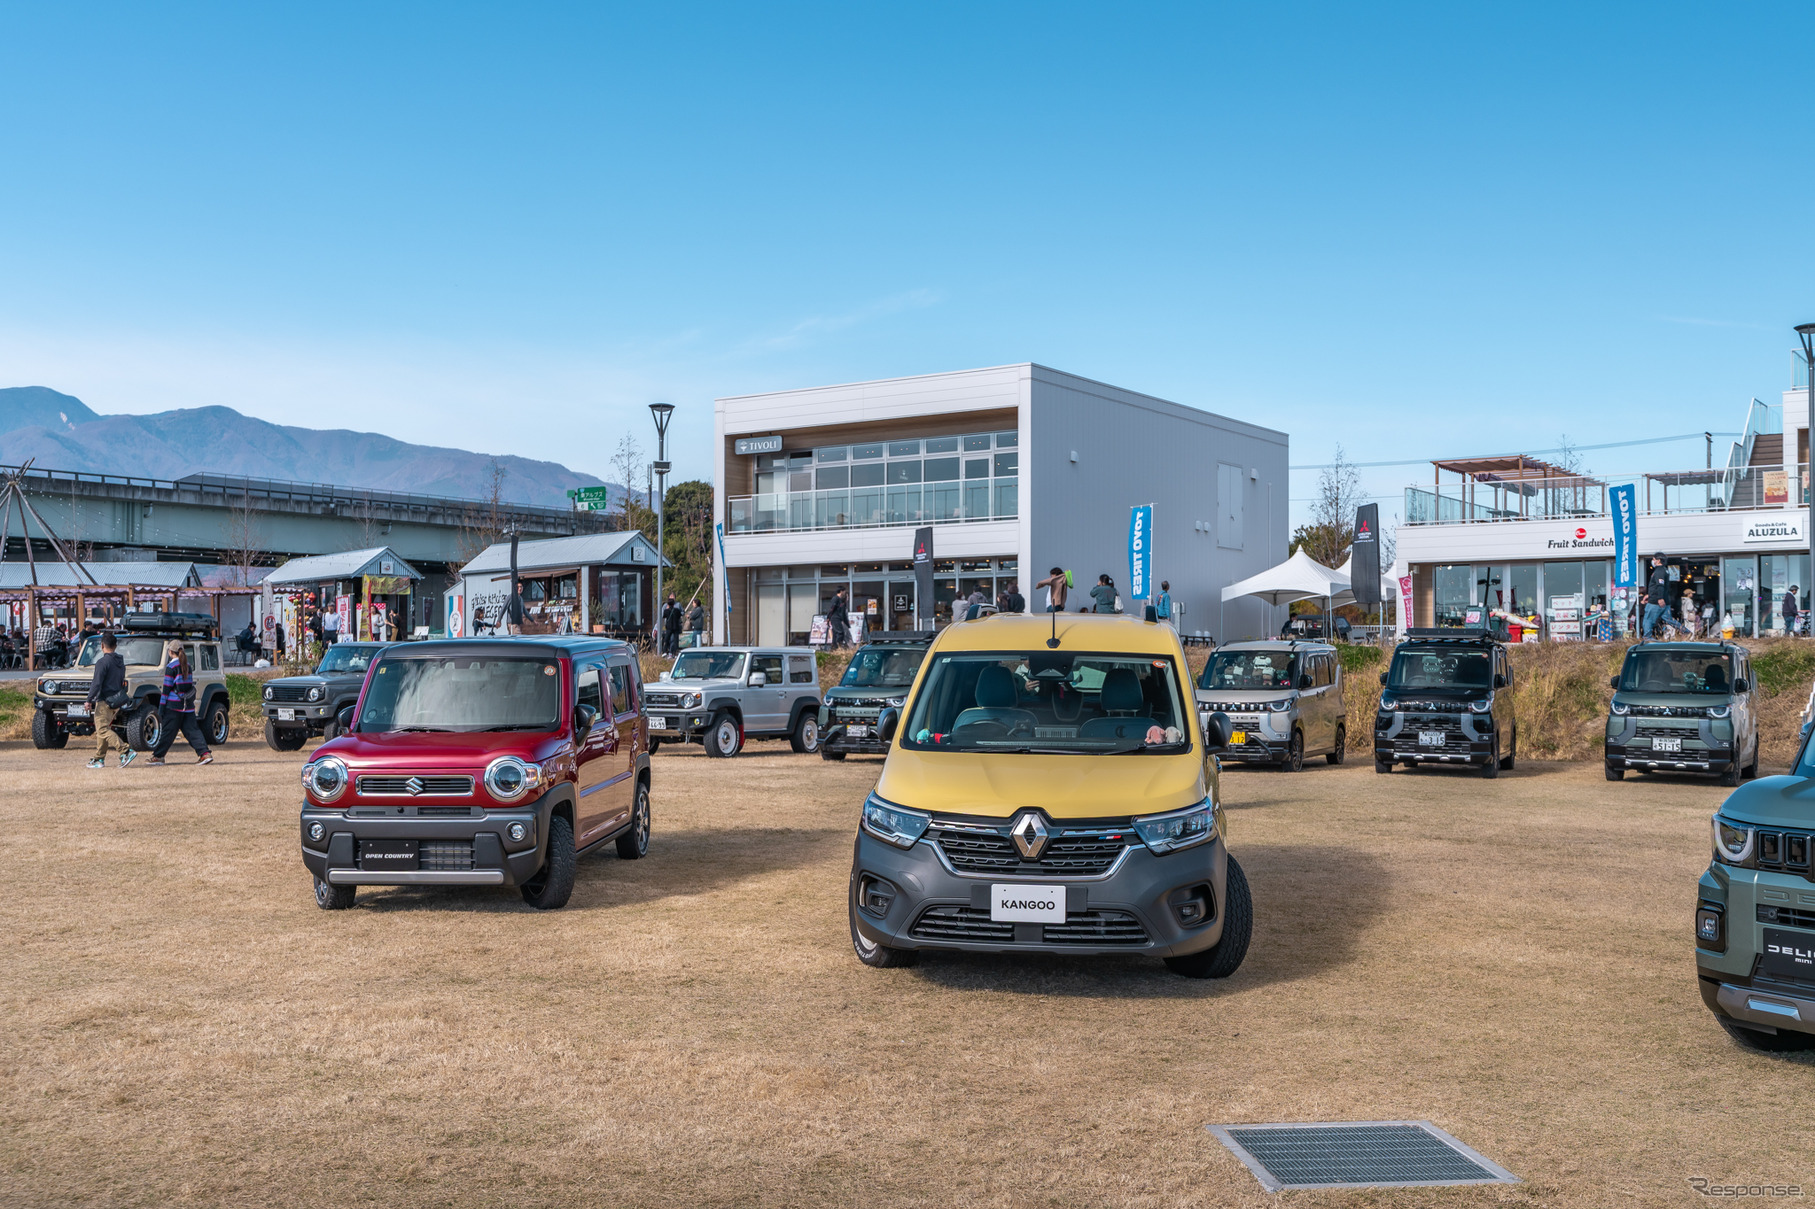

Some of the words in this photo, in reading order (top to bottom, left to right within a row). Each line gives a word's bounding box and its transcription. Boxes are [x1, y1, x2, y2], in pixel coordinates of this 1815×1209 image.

[749, 441, 777, 450] TIVOLI
[1748, 527, 1798, 537] ALUZULA
[1548, 540, 1569, 549] Fruit
[1572, 538, 1614, 548] Sandwich
[1001, 900, 1056, 910] KANGOO
[1767, 944, 1815, 959] DELI
[1794, 957, 1812, 965] mini
